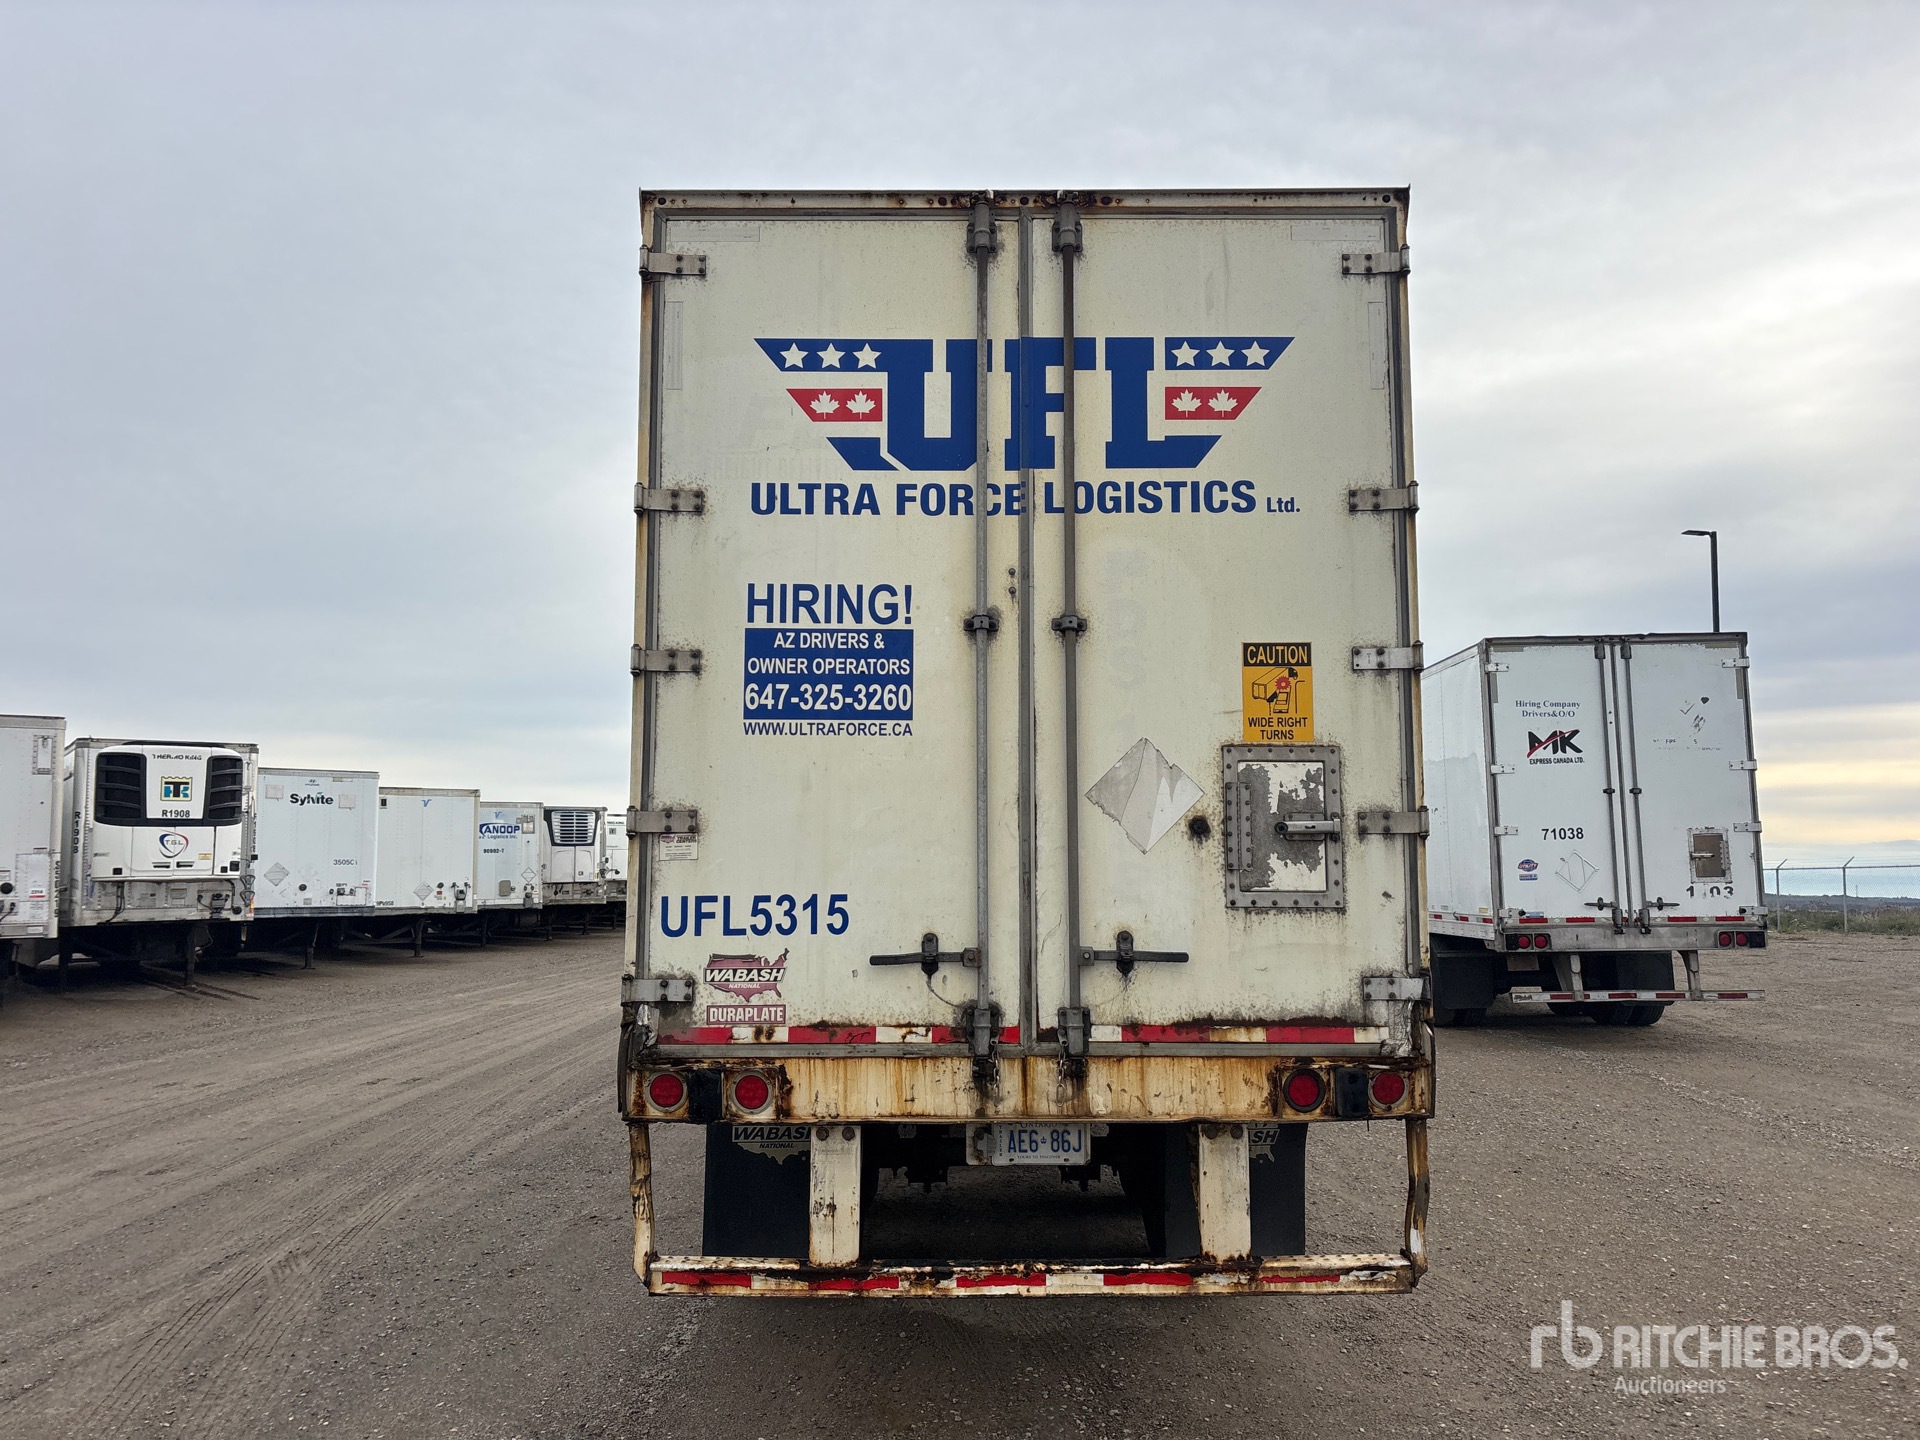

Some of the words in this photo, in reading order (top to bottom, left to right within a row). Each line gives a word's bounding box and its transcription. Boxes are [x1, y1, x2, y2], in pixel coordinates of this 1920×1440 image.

[750, 483, 881, 516] ULTRA
[895, 483, 1027, 516] FORCE
[1044, 480, 1257, 515] LOGISTICS
[1266, 497, 1301, 514] Ltd.
[747, 583, 912, 625] HIRING!
[773, 632, 796, 649] AZ
[799, 632, 869, 650] DRIVERS
[873, 632, 885, 650] &
[1247, 645, 1309, 665] CAUTION
[747, 657, 808, 675] OWNER
[812, 658, 911, 676] OPERATORS
[744, 683, 912, 711] 647-325-3260
[1515, 700, 1541, 709] Hiring
[1543, 700, 1580, 709] Company
[743, 722, 913, 737] WWW.ULTRAFORCE.CA
[1248, 717, 1274, 728] WIDE
[1277, 717, 1308, 728] RIGHT
[1260, 730, 1294, 741] TURNS
[161, 809, 190, 818] R1908
[1541, 827, 1584, 840] 71038
[661, 894, 849, 937] UFL5315
[706, 968, 783, 982] WABASH
[709, 1007, 783, 1022] DURAPLATE
[1008, 1129, 1038, 1153] AE6
[1050, 1129, 1081, 1153] 86J
